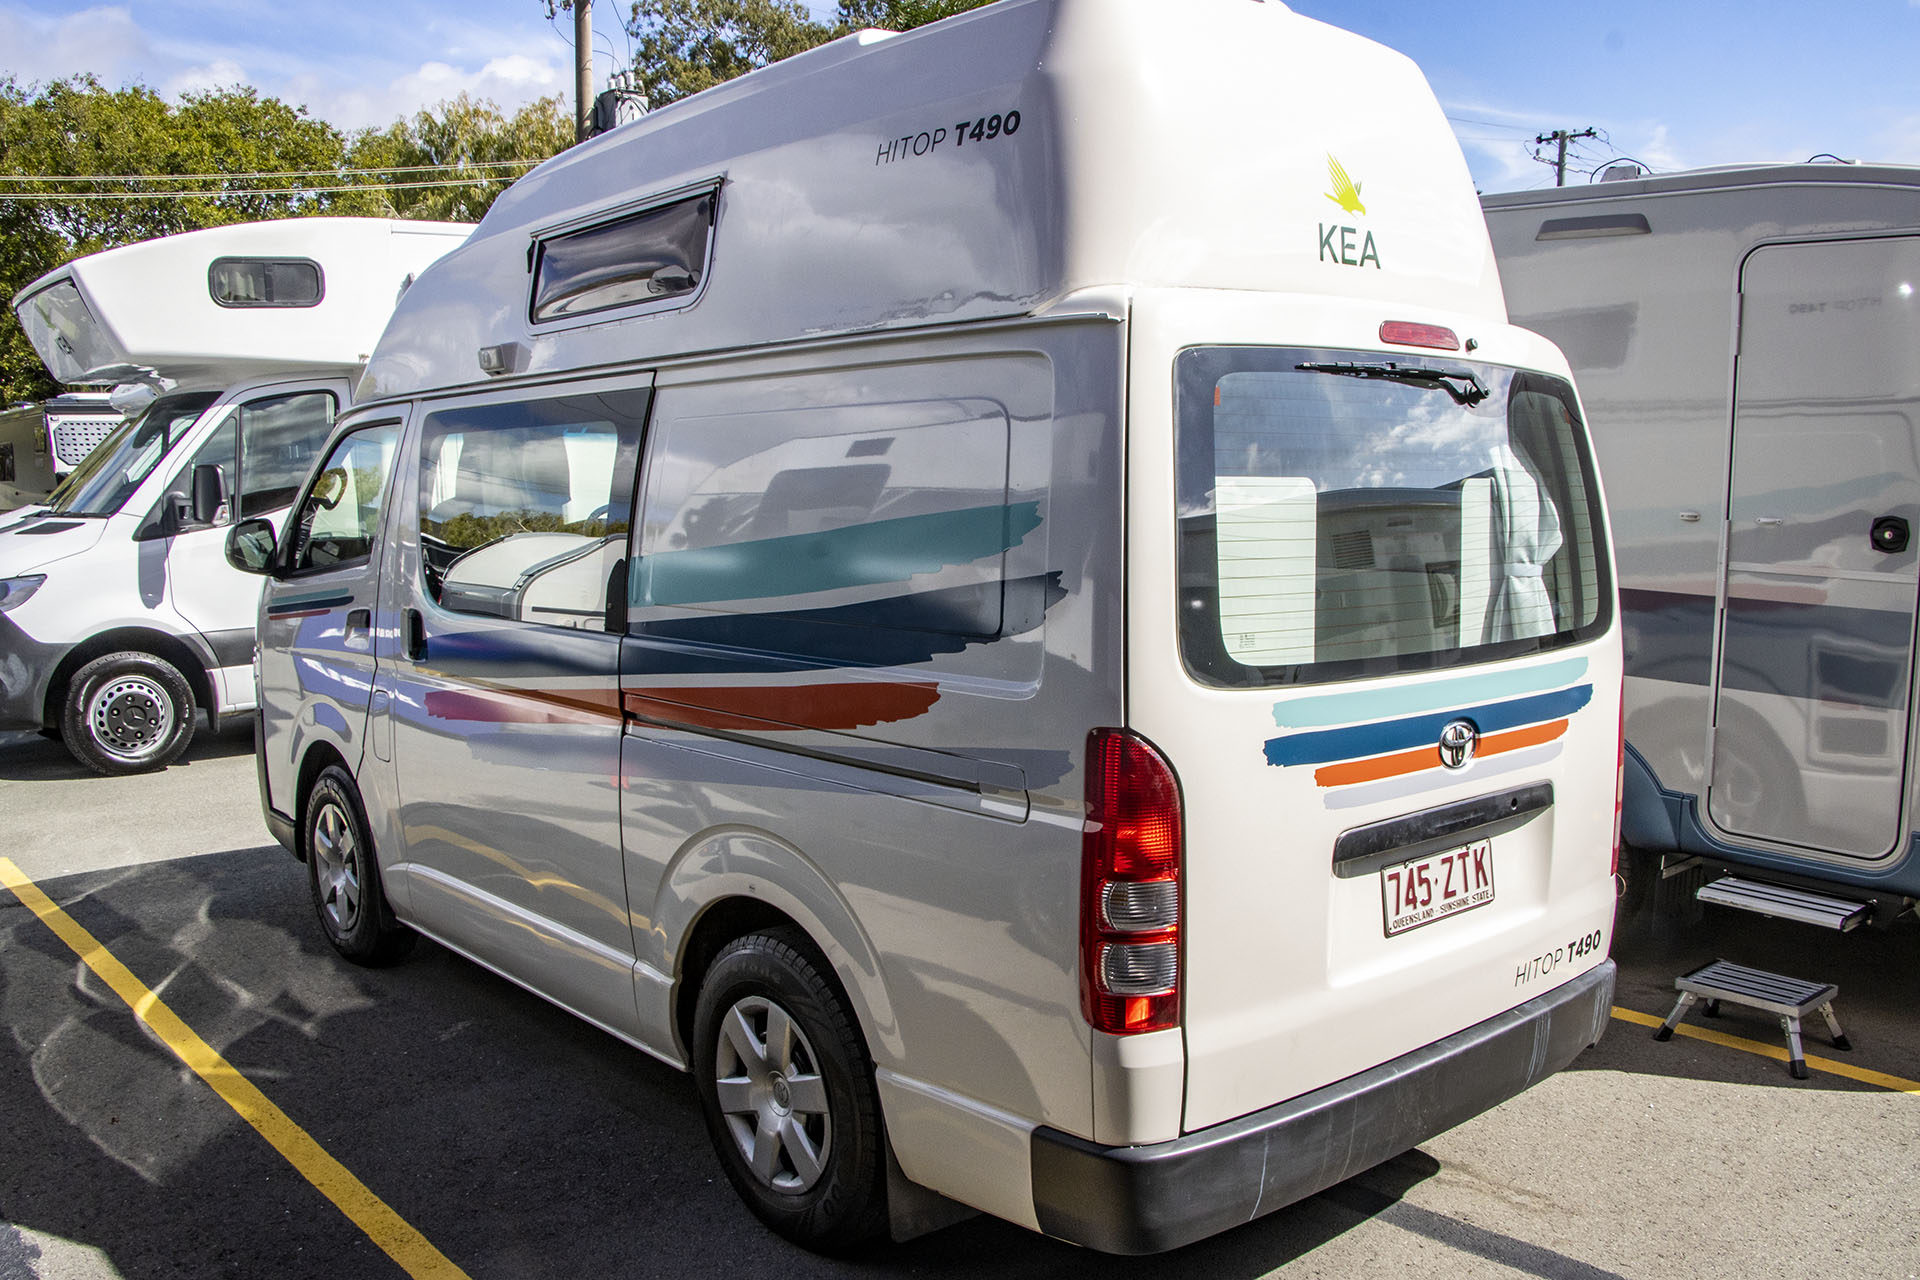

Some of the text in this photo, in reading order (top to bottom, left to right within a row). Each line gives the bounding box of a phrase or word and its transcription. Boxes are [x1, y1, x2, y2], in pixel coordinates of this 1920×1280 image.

[875, 110, 1021, 166] HITOP T490
[1318, 222, 1381, 269] KEA
[1392, 908, 1434, 929] QUEENSLAND
[1440, 896, 1470, 914] SUNSHINE
[1472, 890, 1490, 903] STATE
[1514, 929, 1601, 987] HITOP T490
